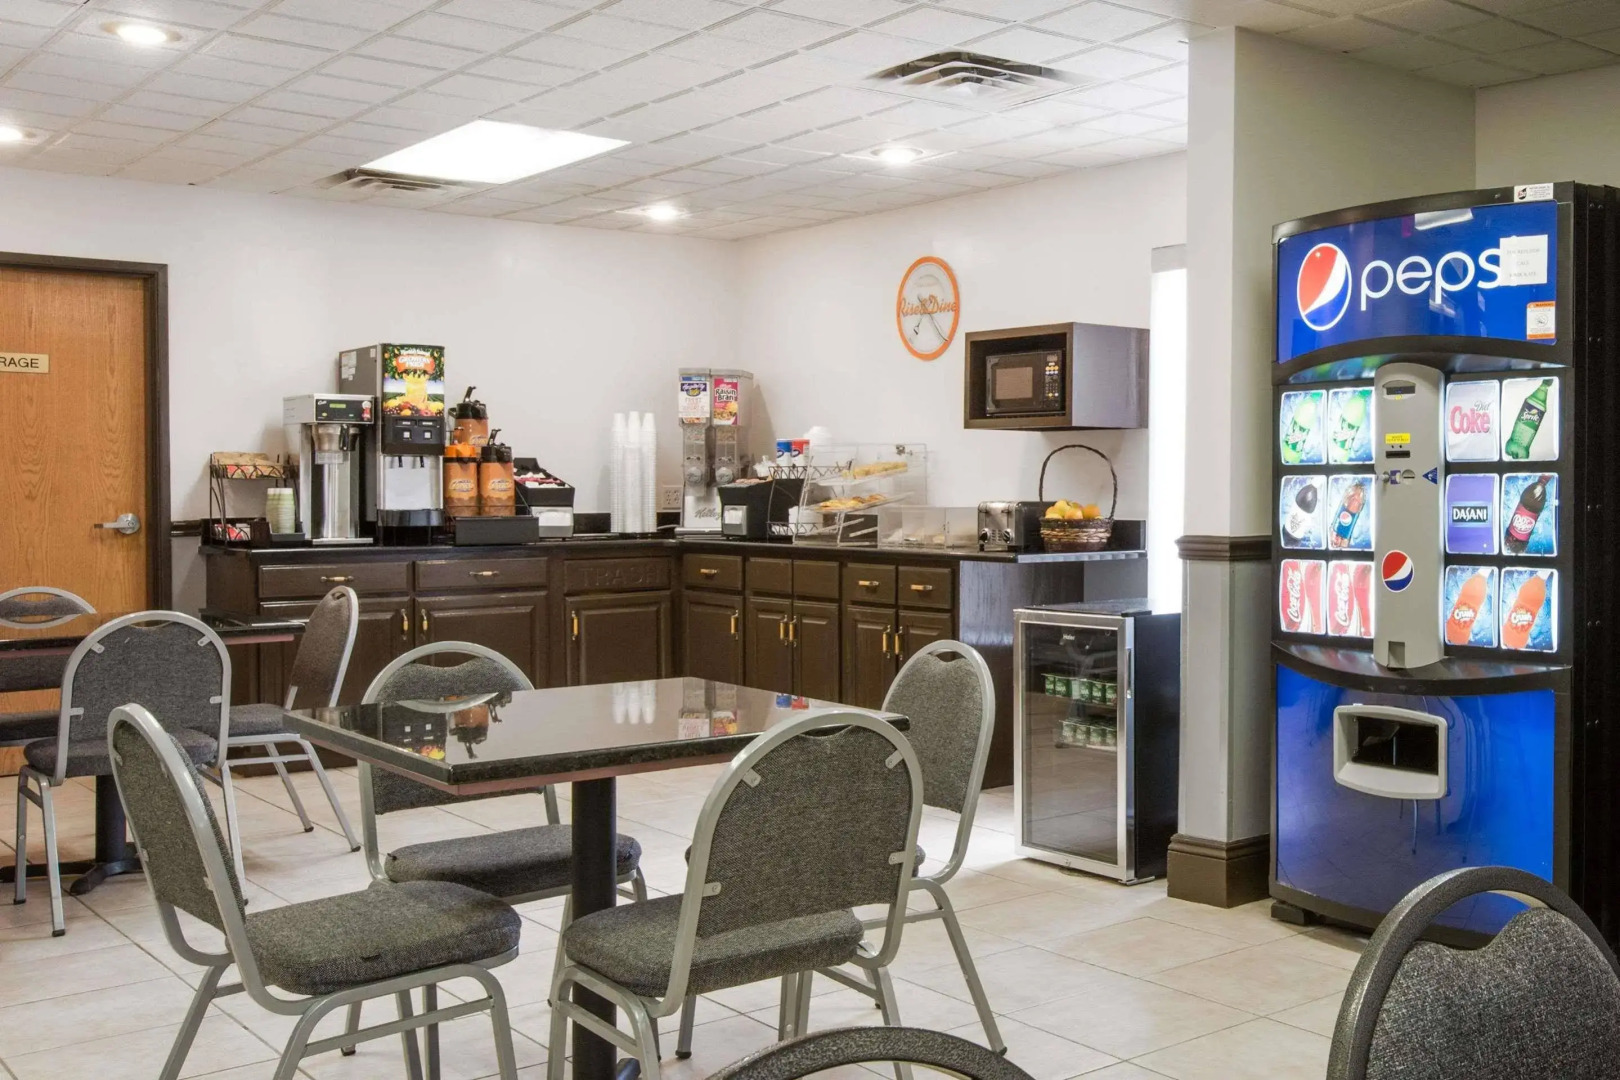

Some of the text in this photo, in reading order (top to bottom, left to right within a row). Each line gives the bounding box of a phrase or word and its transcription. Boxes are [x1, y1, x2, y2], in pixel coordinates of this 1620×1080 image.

[1360, 236, 1518, 311] peps
[0, 356, 40, 368] RAGE
[715, 388, 737, 397] Raisin
[717, 394, 734, 402] Bran
[1474, 400, 1493, 412] Diet
[1450, 405, 1491, 434] Coke
[1452, 506, 1488, 523] DASANI
